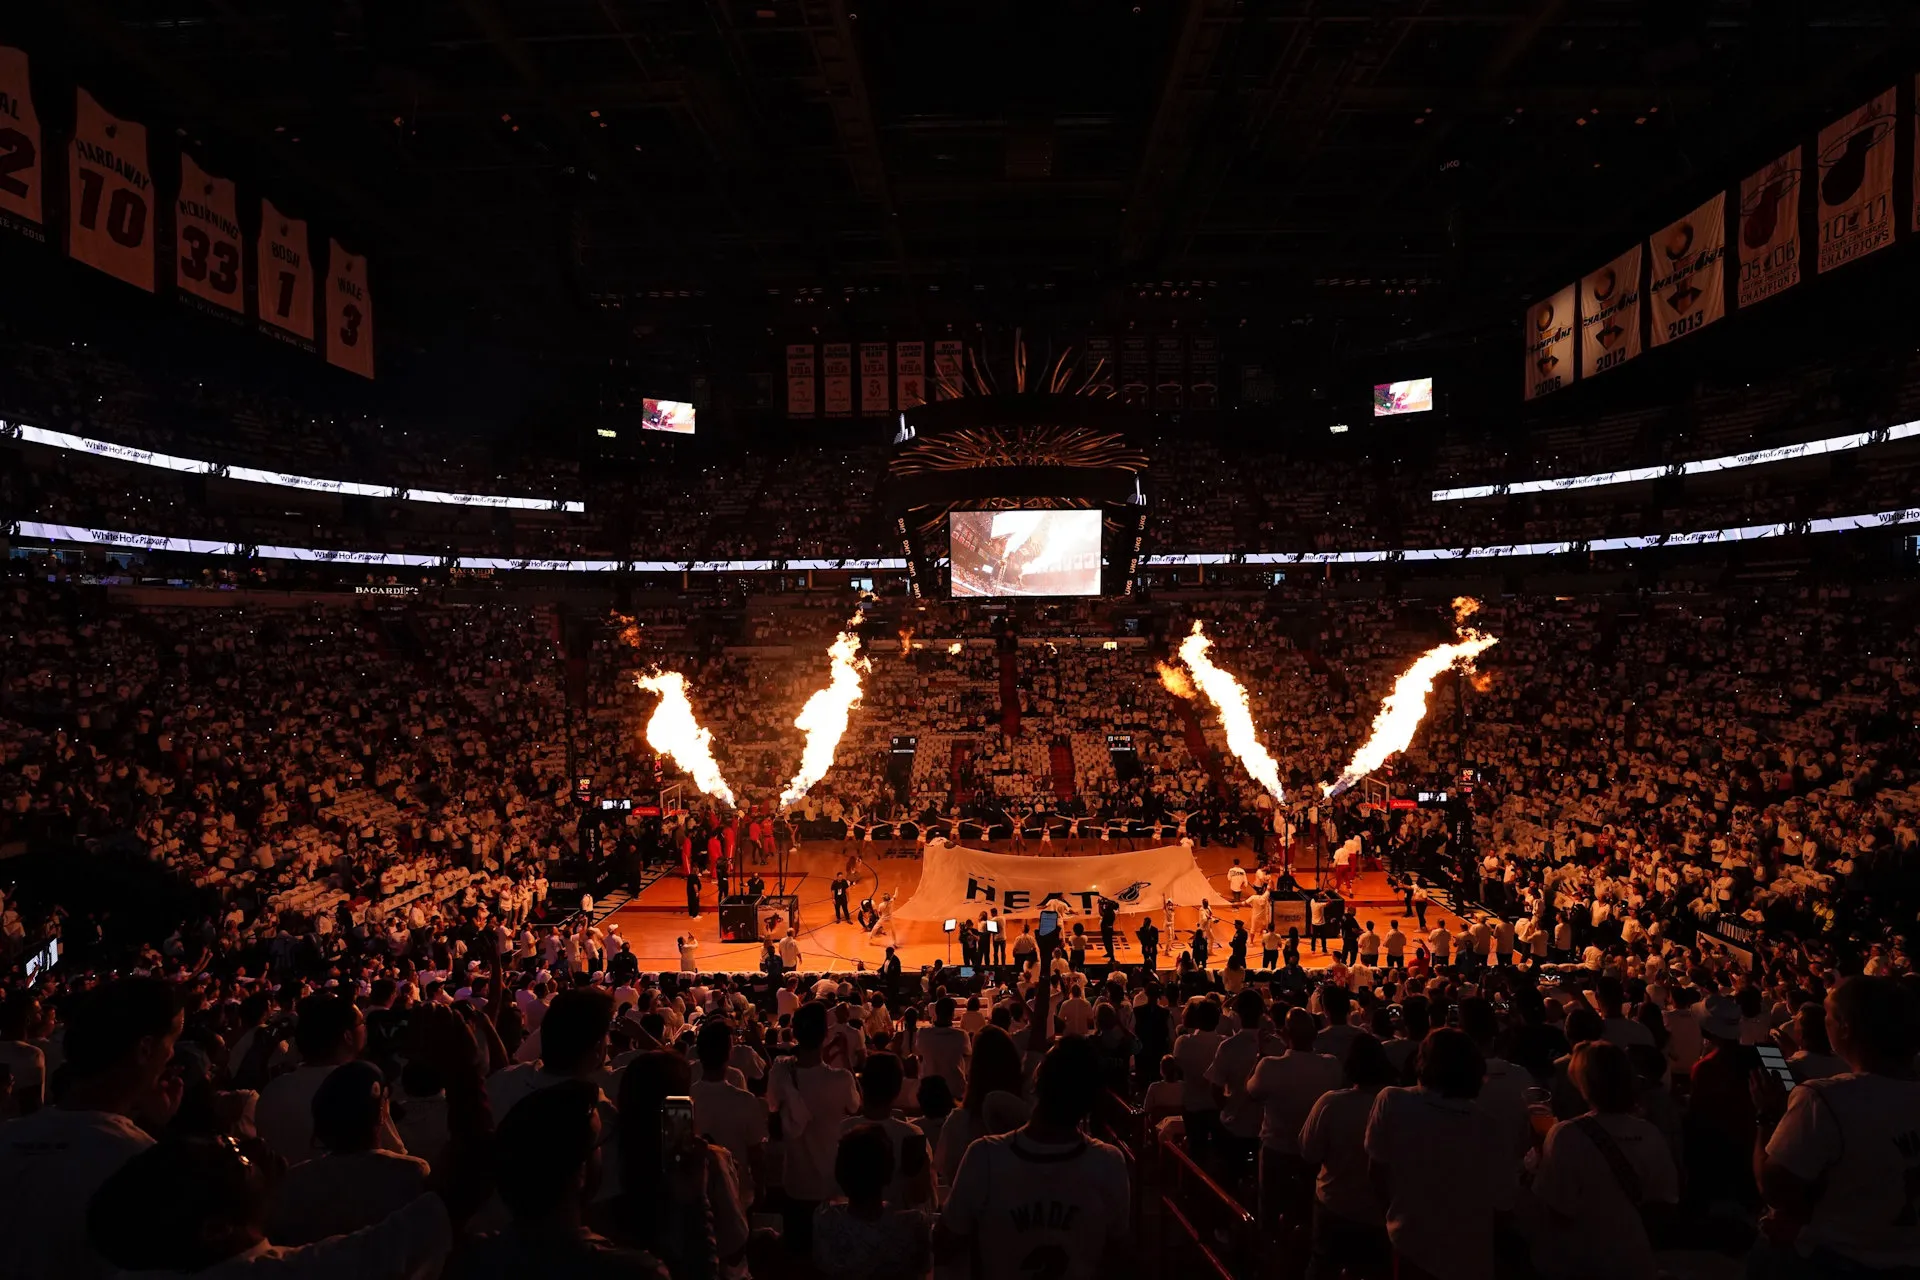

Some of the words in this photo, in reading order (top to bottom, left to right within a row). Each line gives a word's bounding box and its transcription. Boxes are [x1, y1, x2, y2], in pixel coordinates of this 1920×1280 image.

[75, 139, 150, 190] HARDAWAY
[80, 167, 147, 248] 10
[179, 199, 239, 240] MOURNING
[182, 225, 238, 294] 33
[272, 241, 300, 268] BOSH
[1820, 229, 1889, 268] CHAMPIONS
[278, 272, 295, 317] 1
[1741, 271, 1797, 303] CHAMPIONS
[341, 304, 362, 346] 3
[1669, 309, 1703, 338] 2013
[1596, 347, 1626, 373] 2012
[1534, 376, 1561, 397] 2006
[84, 440, 108, 452] White
[898, 517, 906, 534] UKG
[1138, 514, 1146, 530] UKG
[91, 530, 119, 542] White
[903, 539, 911, 556] UKG
[1133, 536, 1142, 552] UKG
[908, 561, 916, 577] UKG
[1129, 558, 1137, 574] UKG
[913, 582, 921, 599] UKG
[1124, 580, 1132, 596] UKG
[966, 877, 1100, 915] HEAT
